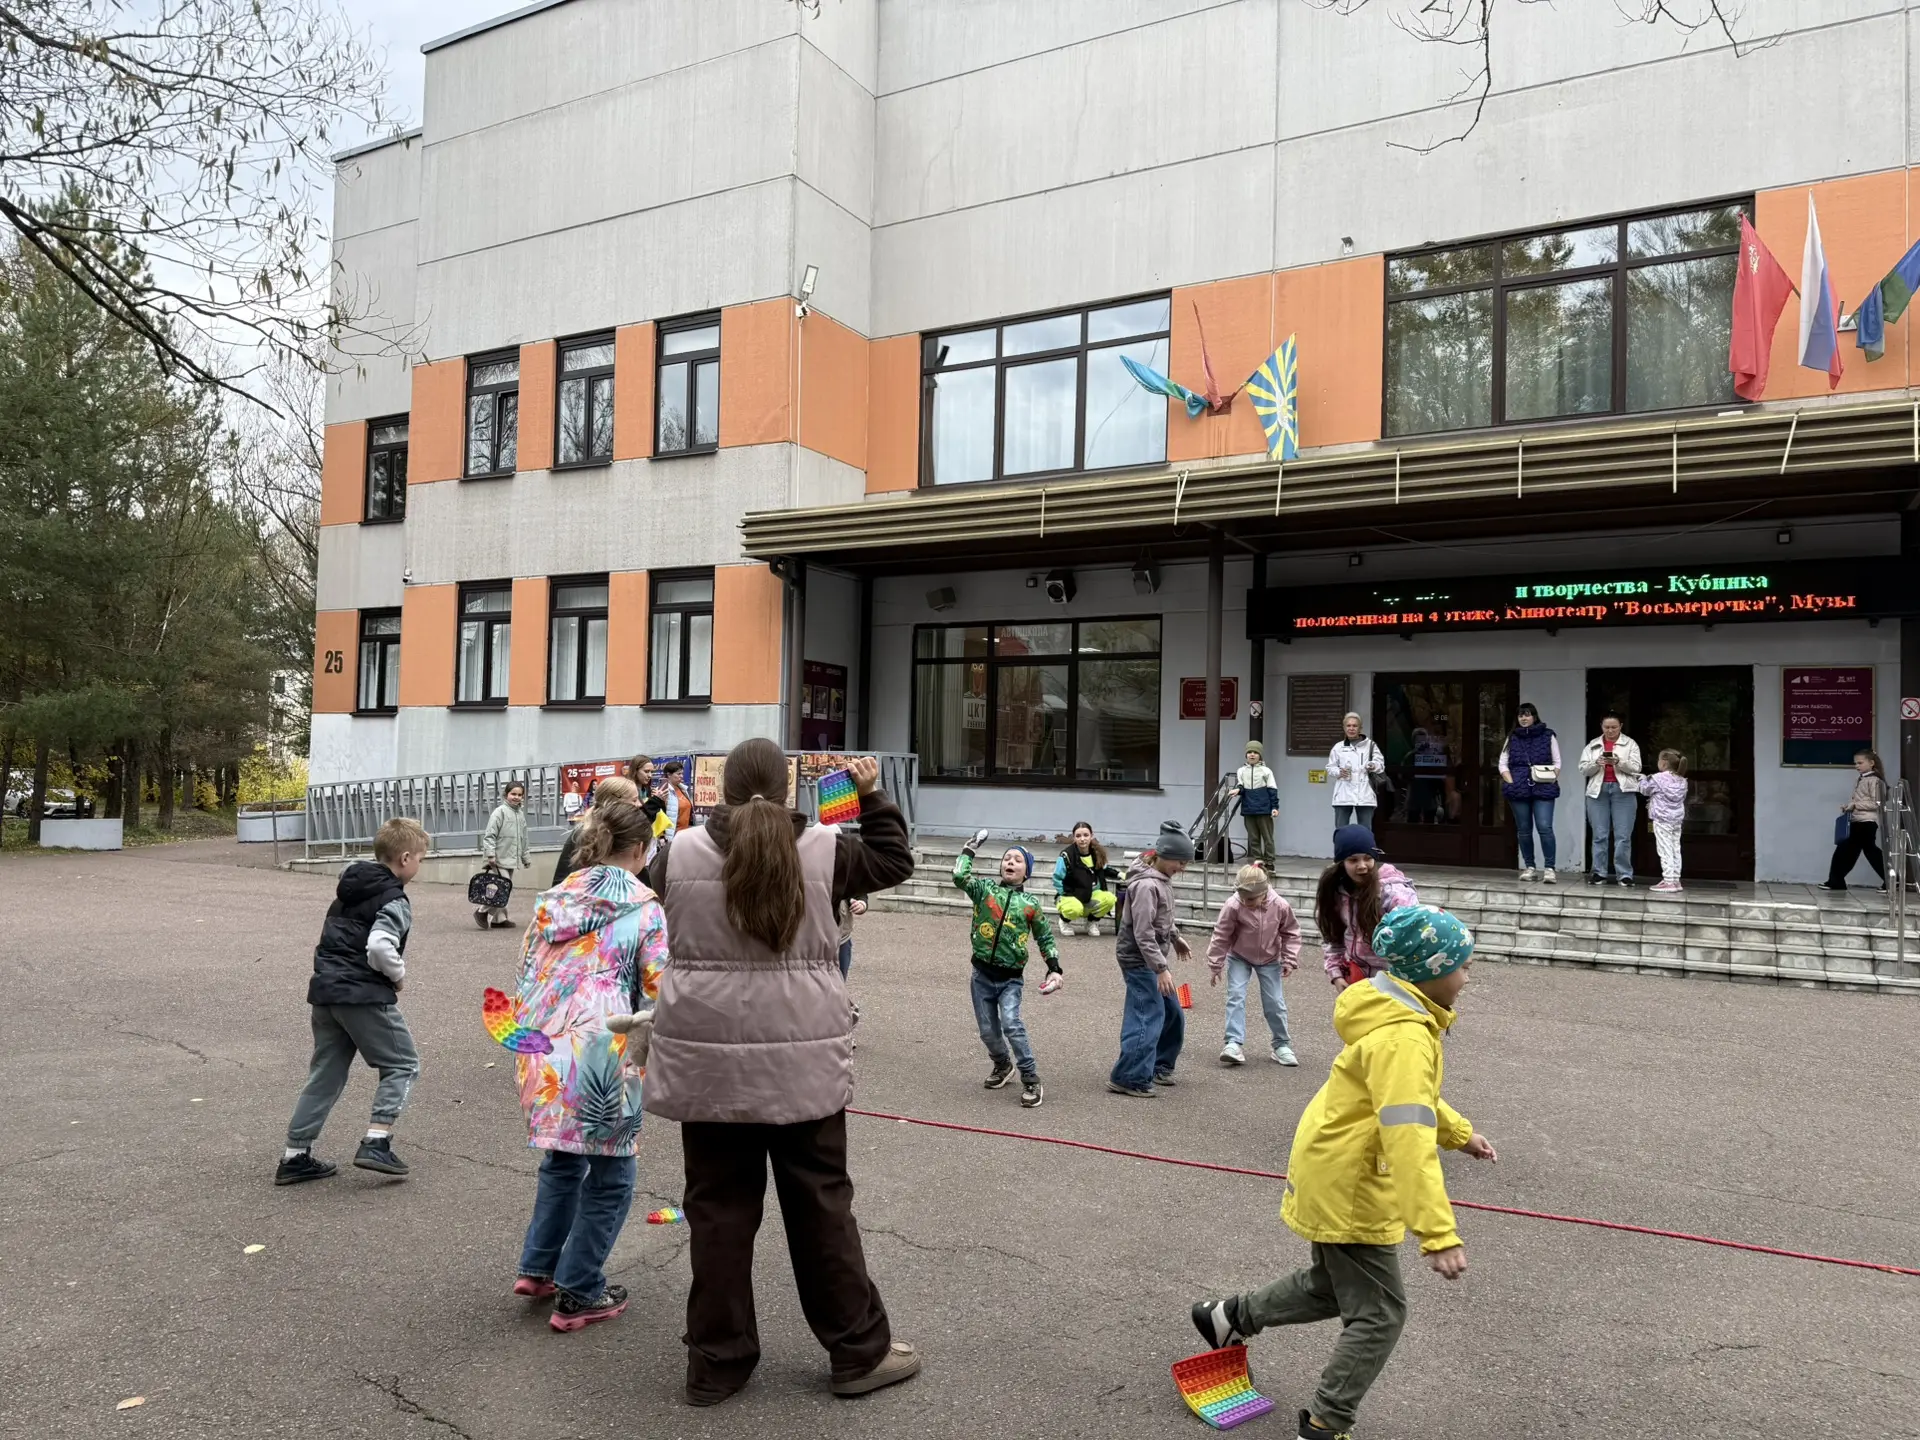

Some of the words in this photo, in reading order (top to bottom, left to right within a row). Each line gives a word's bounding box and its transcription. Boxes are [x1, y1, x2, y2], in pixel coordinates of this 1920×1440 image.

[1532, 581, 1648, 600] творчества
[1667, 574, 1768, 595] Кубинка
[1293, 613, 1398, 628] положенная
[1402, 612, 1423, 623] на
[1429, 611, 1438, 622] 4
[1444, 609, 1499, 622] этаже,
[1504, 604, 1607, 620] Кинотеатр
[1790, 593, 1856, 612] Музы
[324, 649, 344, 674] 25
[967, 703, 985, 719] ЦКТ
[1791, 716, 1817, 724] 9:00
[1830, 716, 1863, 724] 23:00
[567, 768, 578, 778] 25
[699, 791, 716, 802] 17:00
